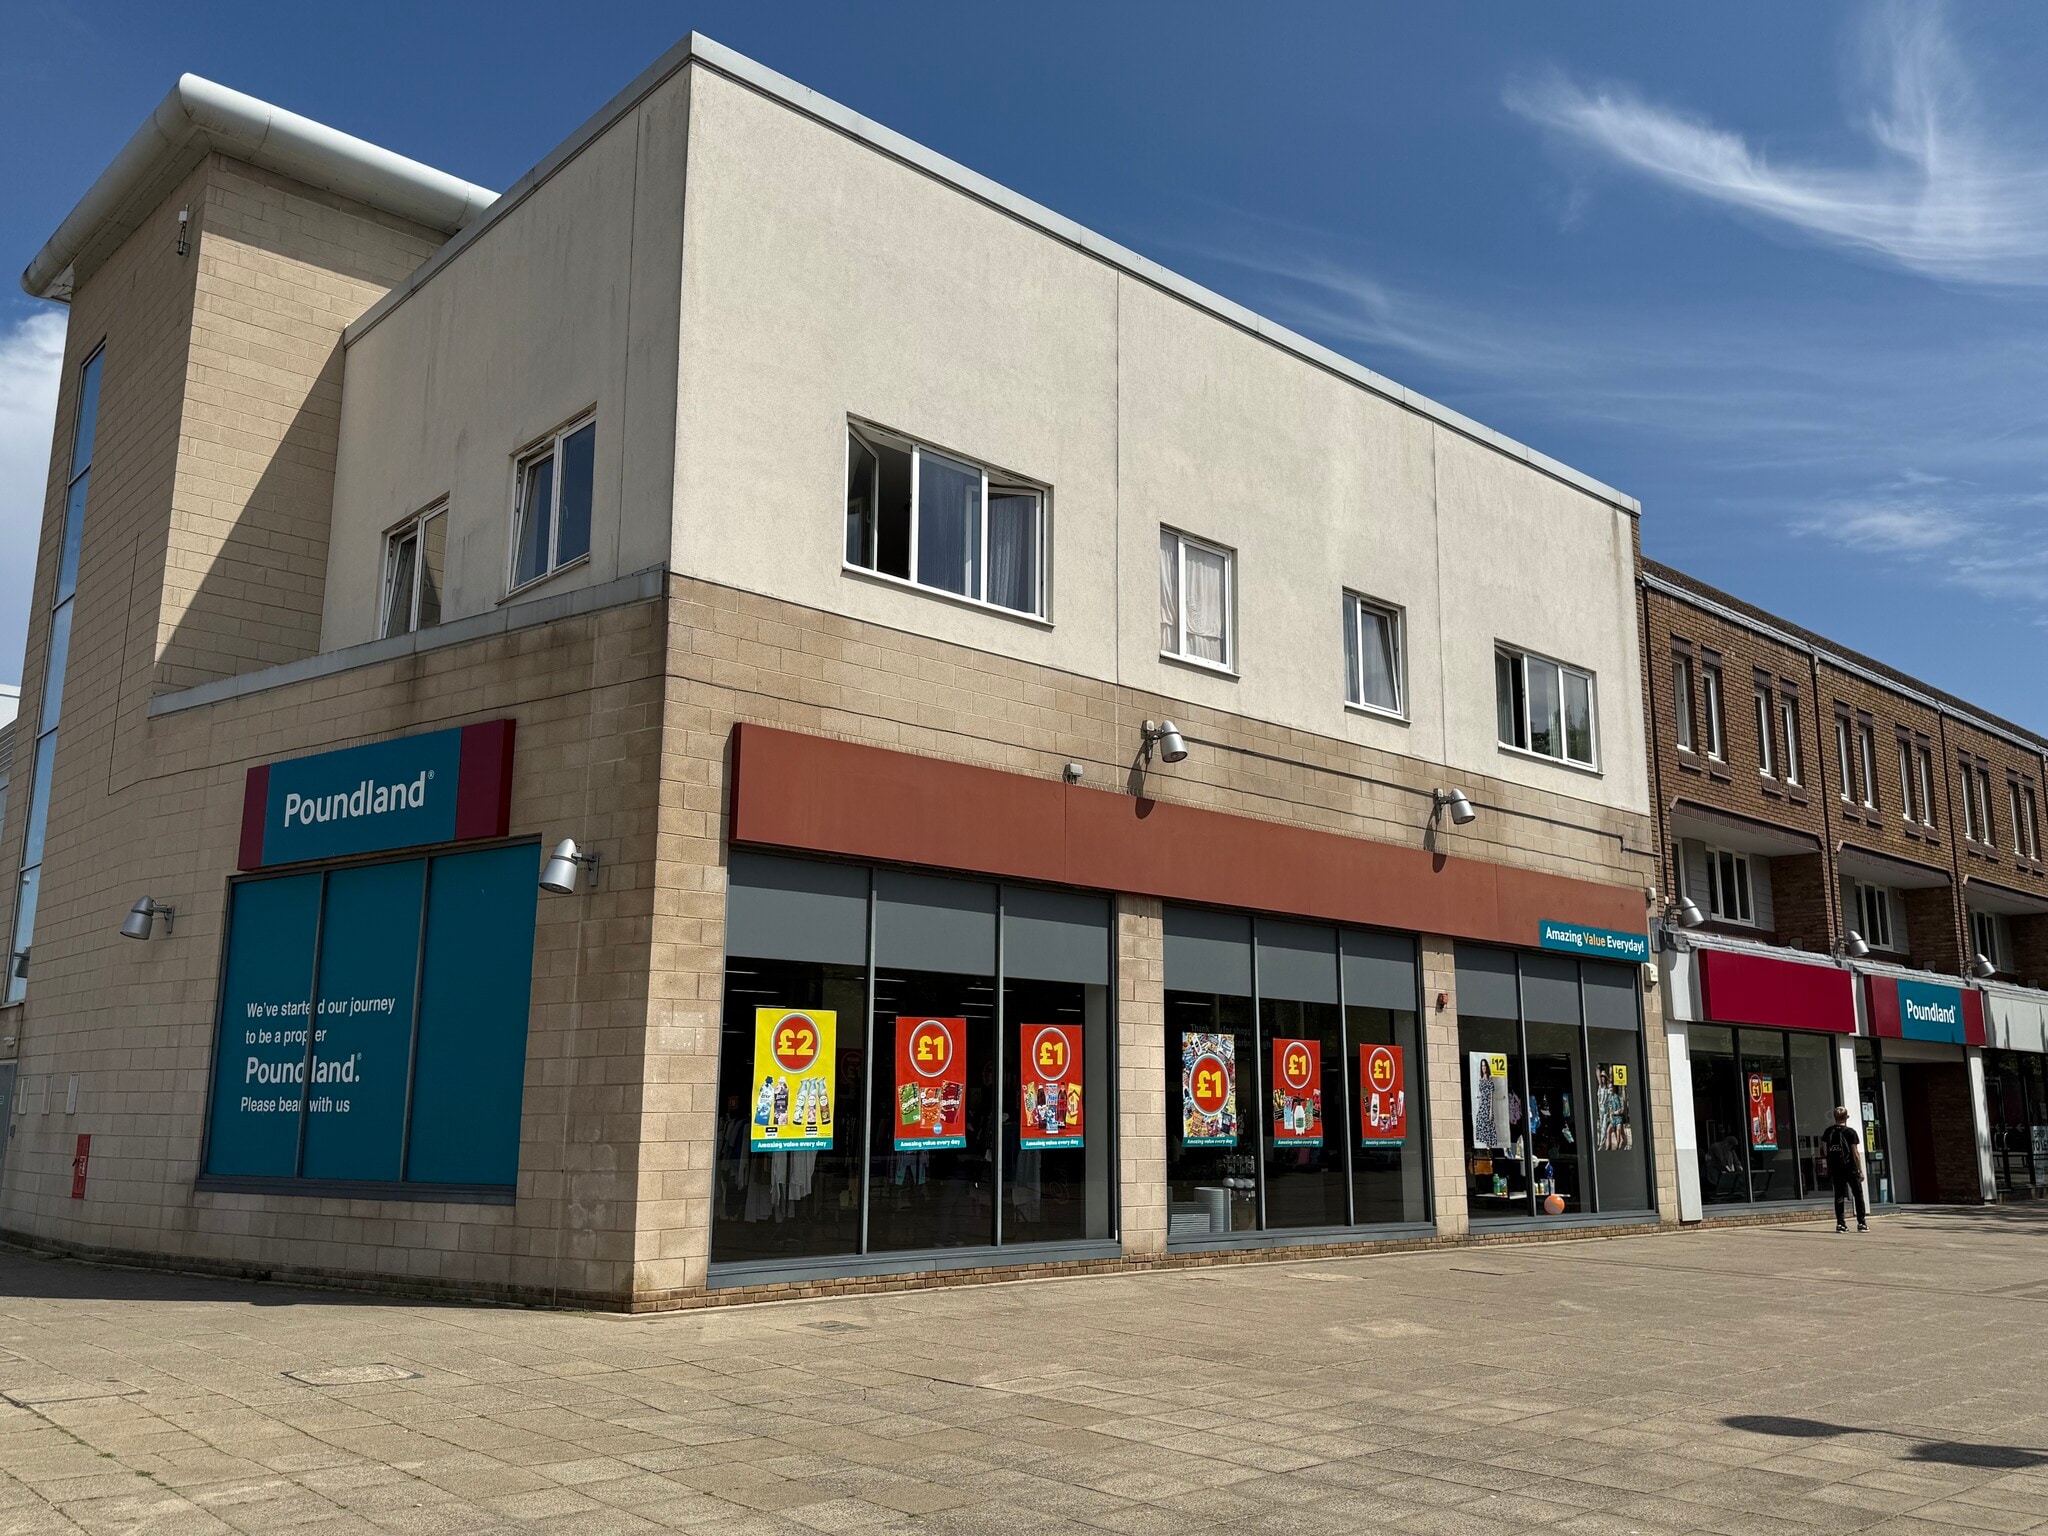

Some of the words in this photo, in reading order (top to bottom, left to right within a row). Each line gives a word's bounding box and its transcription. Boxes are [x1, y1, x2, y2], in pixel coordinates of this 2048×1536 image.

[1546, 926, 1583, 947] Amazing
[1583, 931, 1606, 947] Value
[1606, 935, 1645, 955] Everyday!
[247, 1002, 278, 1018] We've
[281, 999, 325, 1016] started
[328, 1000, 347, 1014] our
[349, 997, 395, 1017] journey
[246, 1029, 256, 1044] to
[259, 1028, 272, 1044] be
[274, 1031, 281, 1043] a
[284, 1029, 327, 1046] proper
[777, 1028, 814, 1056] £2
[917, 1035, 945, 1061] £1
[1039, 1041, 1064, 1065] £1
[1288, 1054, 1307, 1075] £1
[1373, 1059, 1391, 1079] £1
[1491, 1058, 1506, 1072] £12
[1615, 1066, 1624, 1080] £6
[1196, 1069, 1222, 1098] £1
[240, 1096, 276, 1112] Please
[309, 1096, 333, 1113] with
[336, 1099, 350, 1113] us
